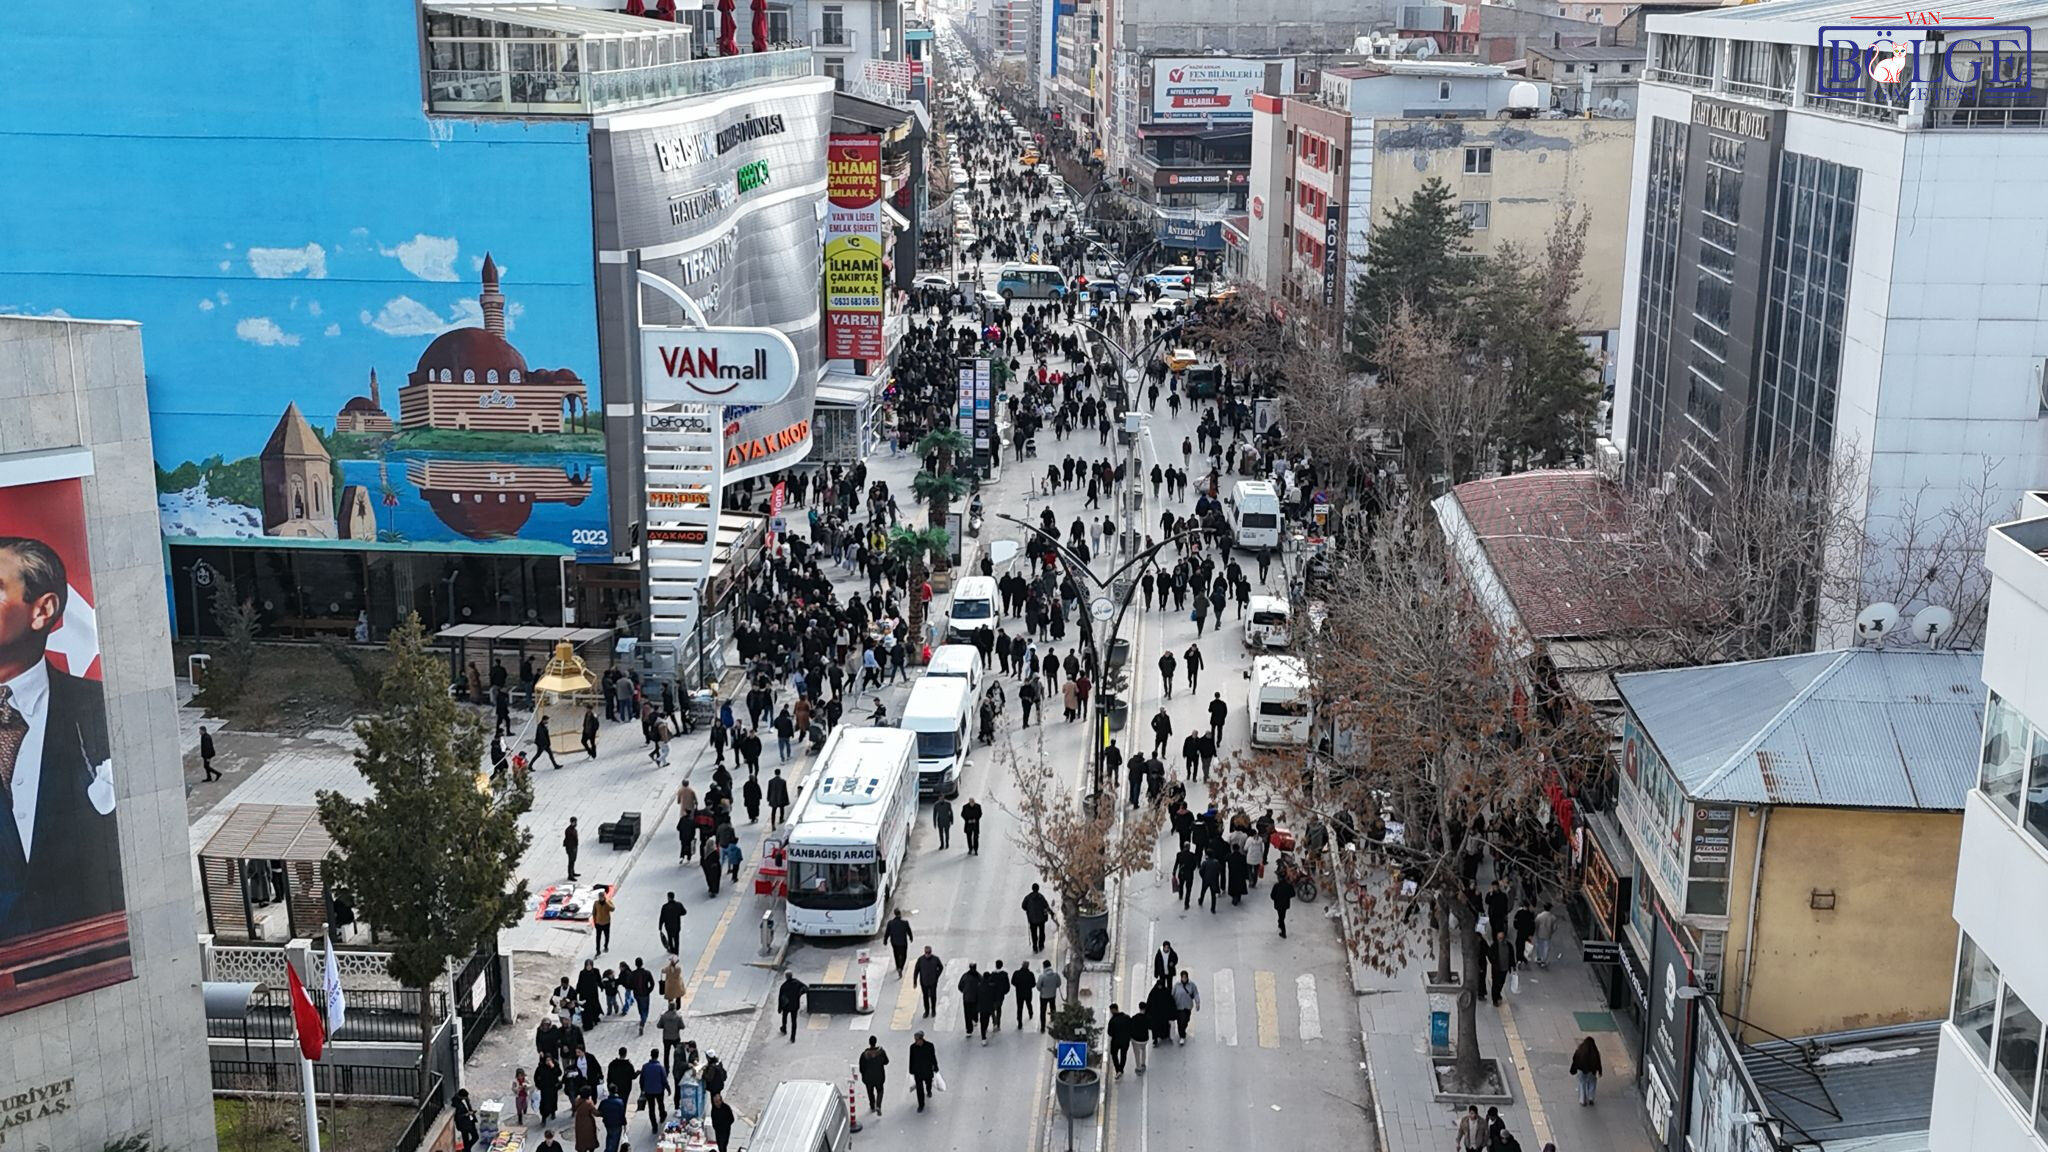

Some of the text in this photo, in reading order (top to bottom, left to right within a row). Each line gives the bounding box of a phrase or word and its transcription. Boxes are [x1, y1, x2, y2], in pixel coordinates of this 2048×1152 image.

[1711, 104, 1738, 133] PALACE
[1739, 110, 1768, 140] HOTEL
[828, 160, 877, 175] İLHAMİ
[829, 176, 877, 188] ÇAKIRTAŞ
[829, 189, 858, 197] EMLAK
[829, 224, 851, 233] EMLAK
[1327, 219, 1337, 262] ROZ
[830, 258, 878, 272] İLHAMİ
[830, 273, 878, 285] ÇAKIRTAŞ
[831, 286, 859, 294] EMLAK
[831, 314, 879, 326] YAREN
[650, 415, 704, 428] DeFacto
[571, 528, 608, 545] 2023
[649, 531, 706, 541] AYAKMOD
[789, 848, 875, 859] KANBAĞIŞI ARACI
[0, 1077, 75, 1112] URİYET
